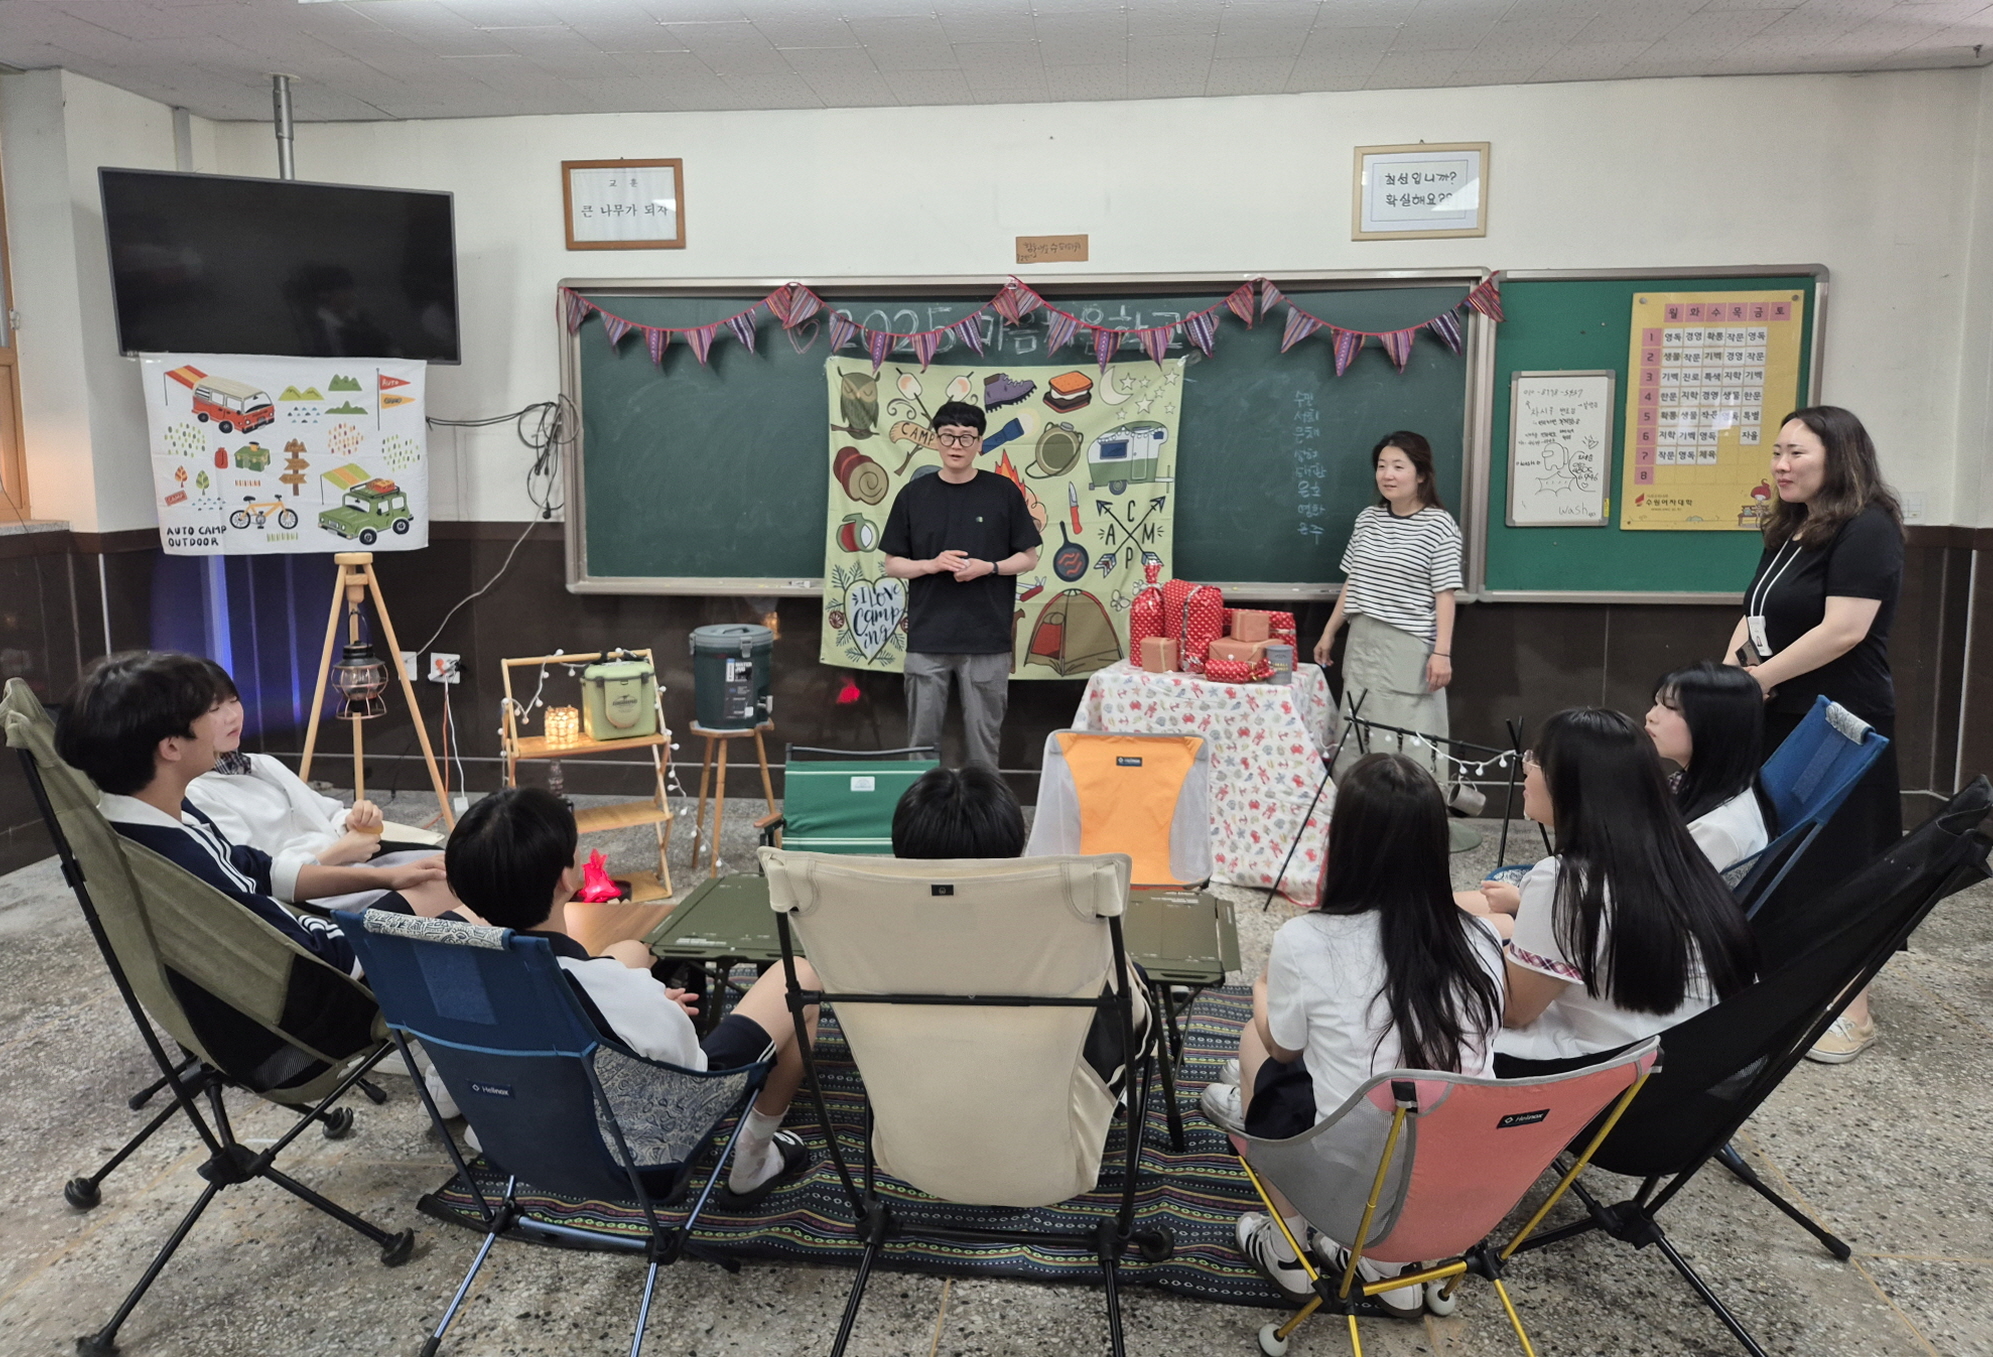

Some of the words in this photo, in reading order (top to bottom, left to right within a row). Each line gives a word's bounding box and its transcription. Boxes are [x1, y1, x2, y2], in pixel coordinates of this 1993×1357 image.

[581, 205, 593, 218] 큰
[600, 204, 637, 217] 나무가
[644, 203, 668, 216] 되자
[1669, 308, 1678, 319] 월
[1690, 308, 1699, 316] 화
[1733, 307, 1742, 317] 목
[1754, 308, 1763, 317] 금
[1727, 333, 1744, 342] 작문
[1684, 353, 1700, 362] 작문
[1747, 352, 1764, 361] 작문
[1646, 373, 1652, 381] 3
[1683, 373, 1699, 381] 진로
[901, 422, 935, 446] CAMP
[1643, 432, 1649, 440] 6
[1658, 451, 1674, 460] 작문
[1127, 499, 1135, 522] C
[167, 526, 195, 536] AUTO
[198, 525, 227, 536] CAMP
[1105, 523, 1116, 546] A
[1141, 522, 1155, 545] M
[168, 537, 219, 547] OUTDOOR
[1125, 546, 1133, 569] P
